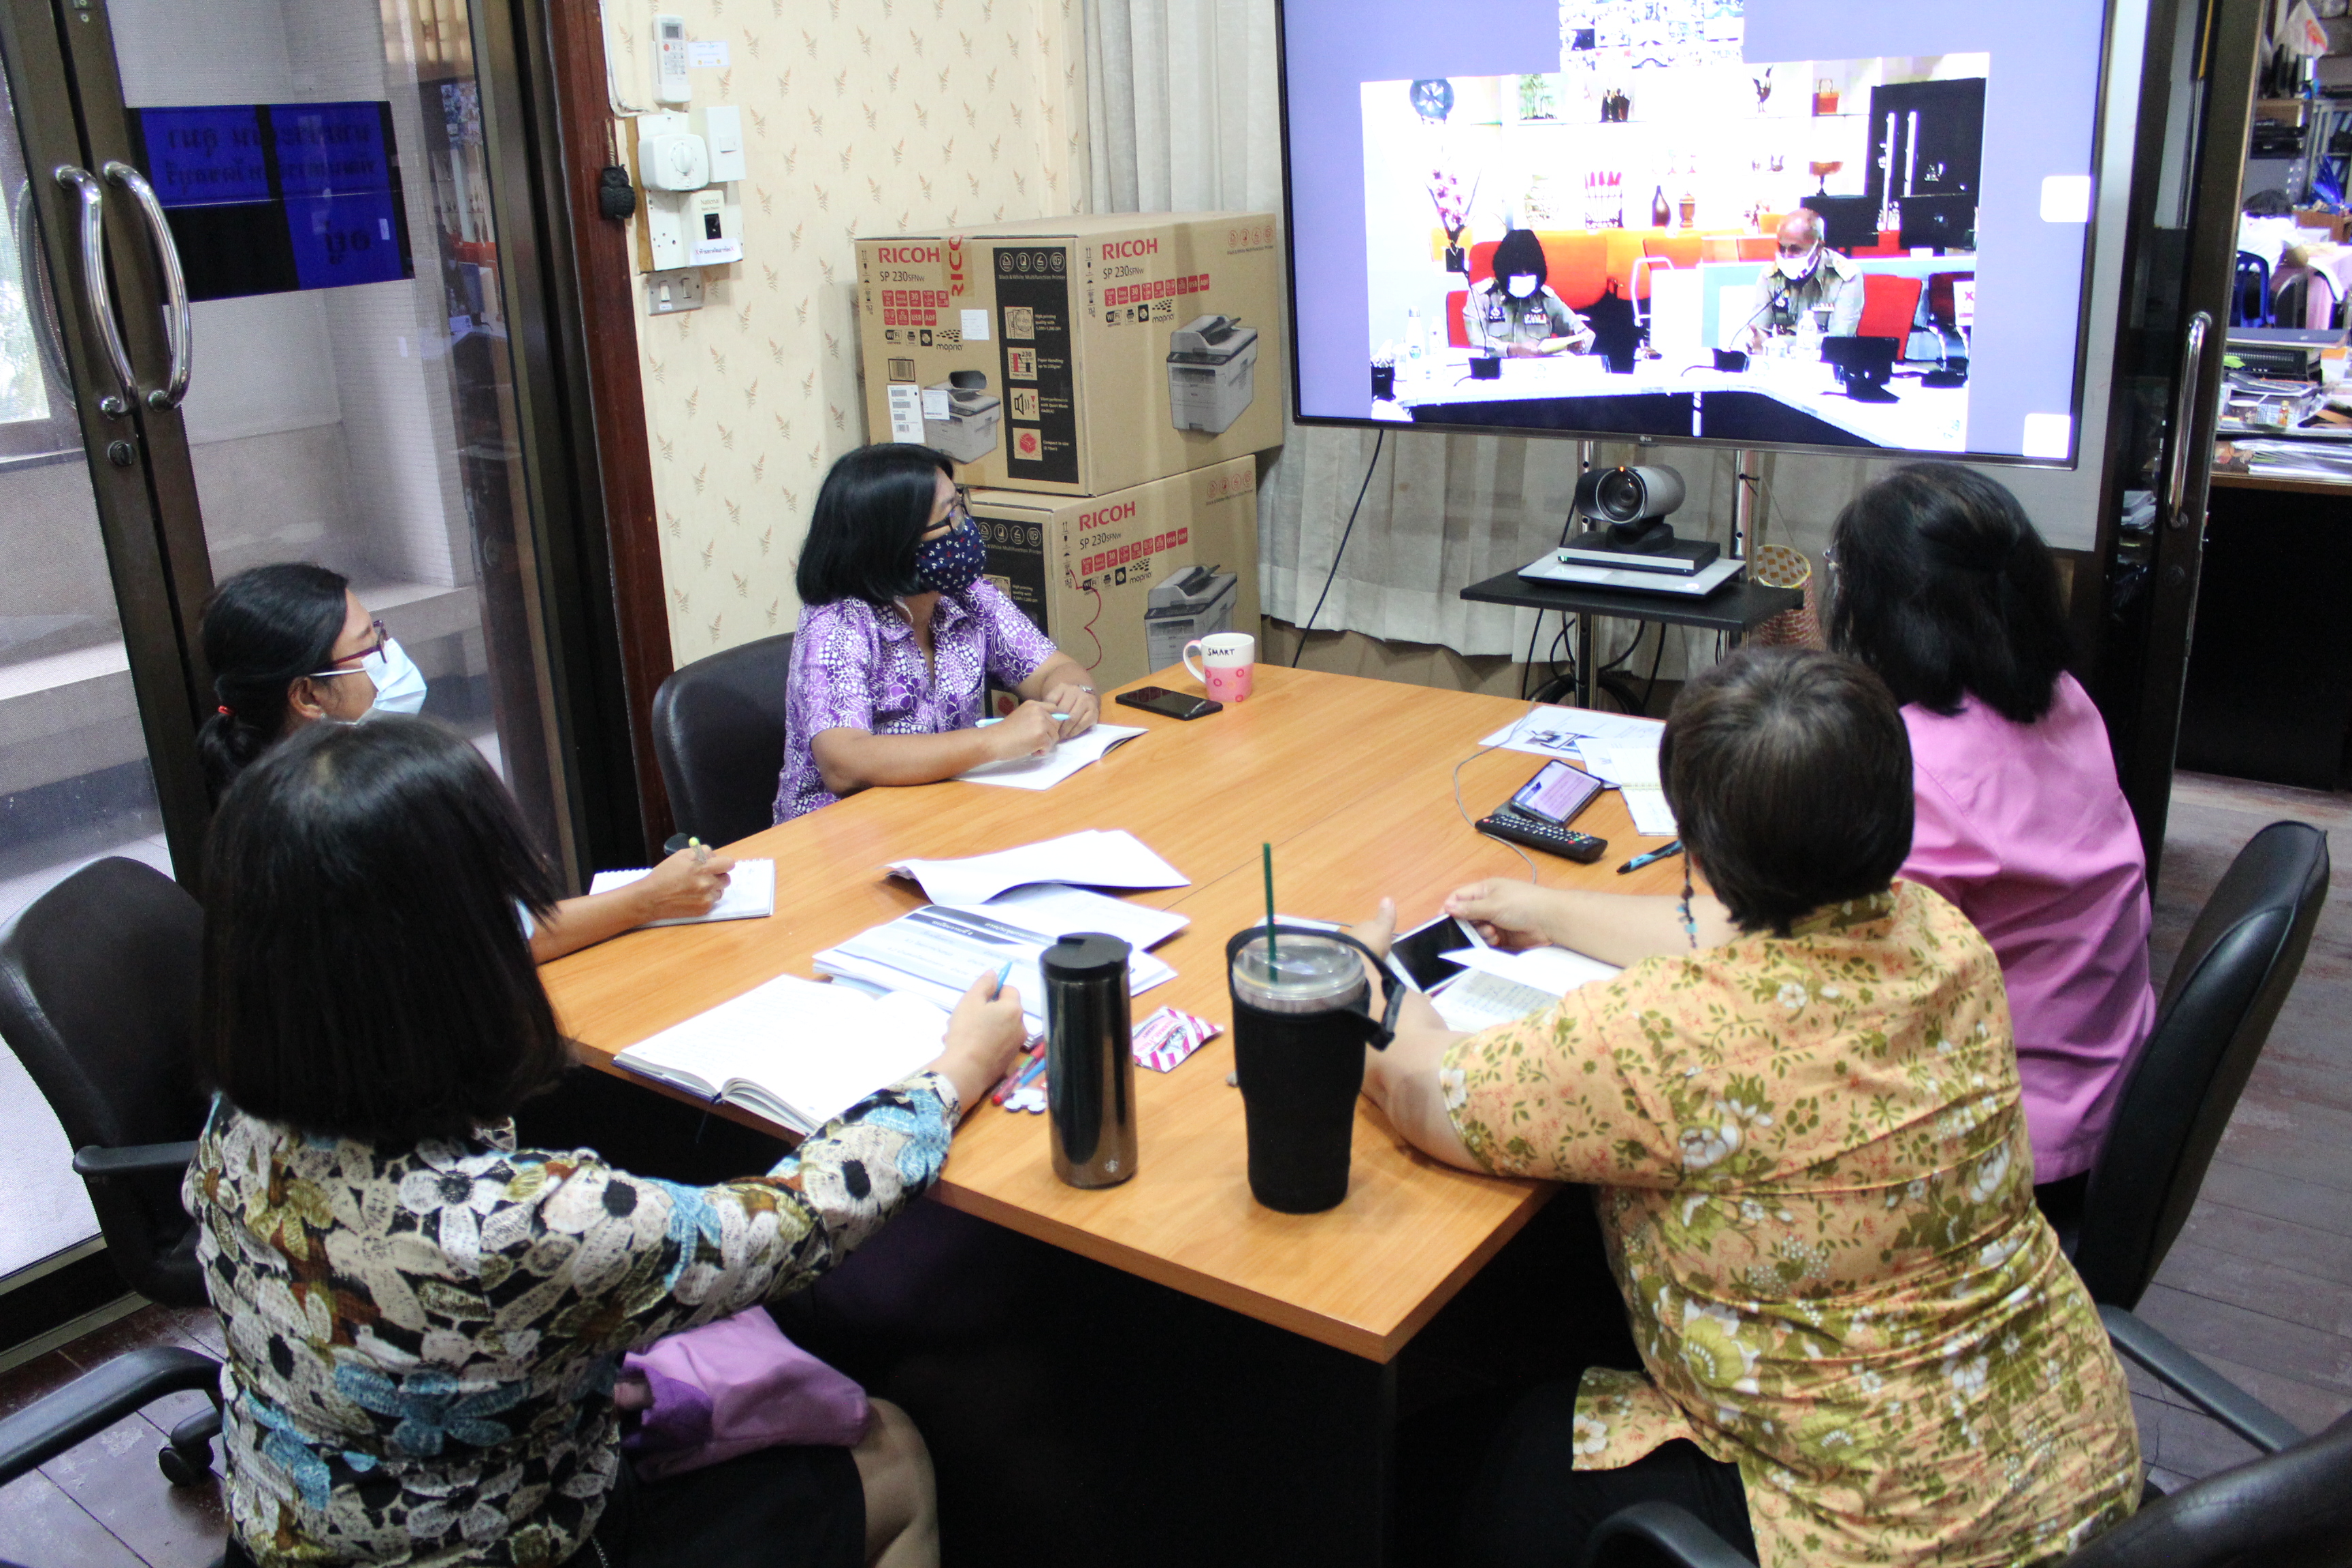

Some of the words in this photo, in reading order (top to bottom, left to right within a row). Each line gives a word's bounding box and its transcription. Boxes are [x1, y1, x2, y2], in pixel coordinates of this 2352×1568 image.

[878, 247, 941, 263] RICOH
[1102, 238, 1158, 261] RICOH
[880, 271, 890, 282] SP
[1103, 267, 1113, 280] SP
[1131, 287, 1139, 295] 30
[911, 293, 919, 301] 30
[1152, 314, 1175, 325] mopria
[936, 344, 964, 353] mopria
[1079, 501, 1136, 532] RICOH
[1166, 536, 1176, 544] USB
[1178, 532, 1188, 540] ADF
[1079, 538, 1090, 550] SP
[1109, 553, 1116, 561] 30
[1129, 572, 1152, 585] mopria
[1207, 648, 1235, 657] SMART
[1143, 1024, 1158, 1039] CHERRY
